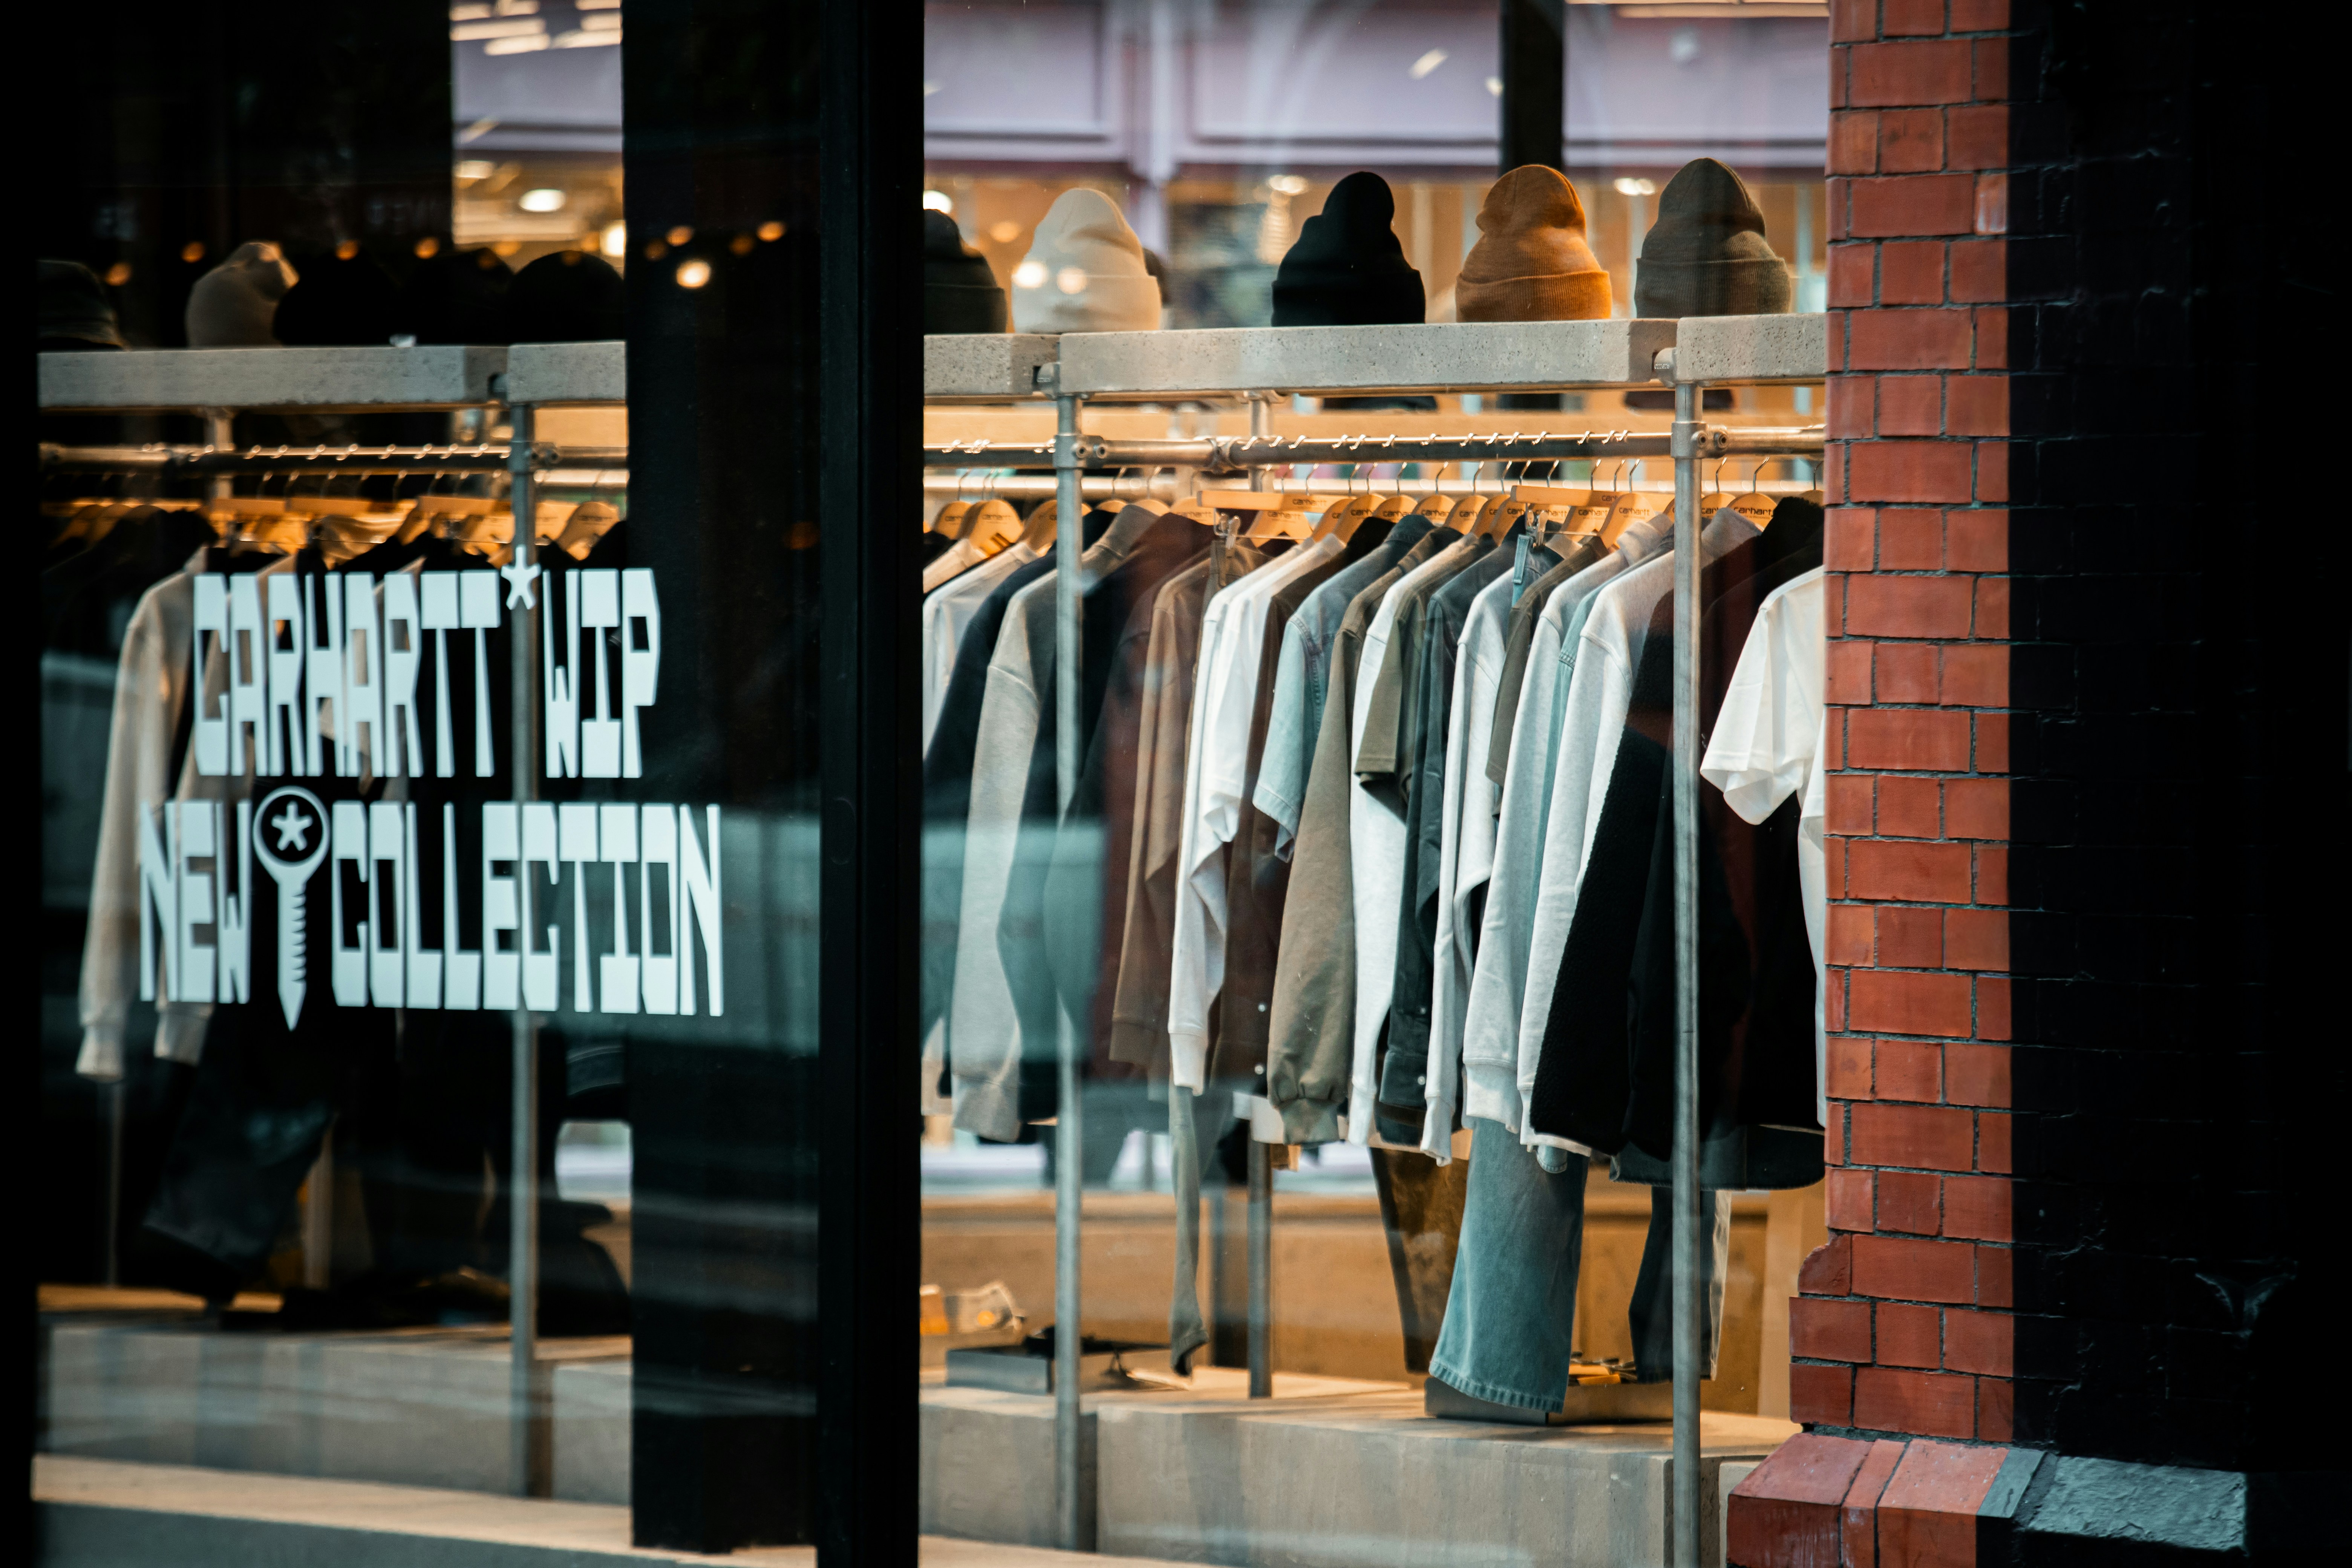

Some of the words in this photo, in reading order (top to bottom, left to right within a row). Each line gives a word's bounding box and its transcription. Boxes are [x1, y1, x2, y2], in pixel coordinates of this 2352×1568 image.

[1619, 508, 1649, 516] carhartt
[1733, 507, 1773, 517] carhart
[194, 572, 500, 777] CARHARTT
[543, 568, 660, 778] WIP
[139, 799, 253, 1004] NEW
[332, 801, 723, 1017] COLLECTION
